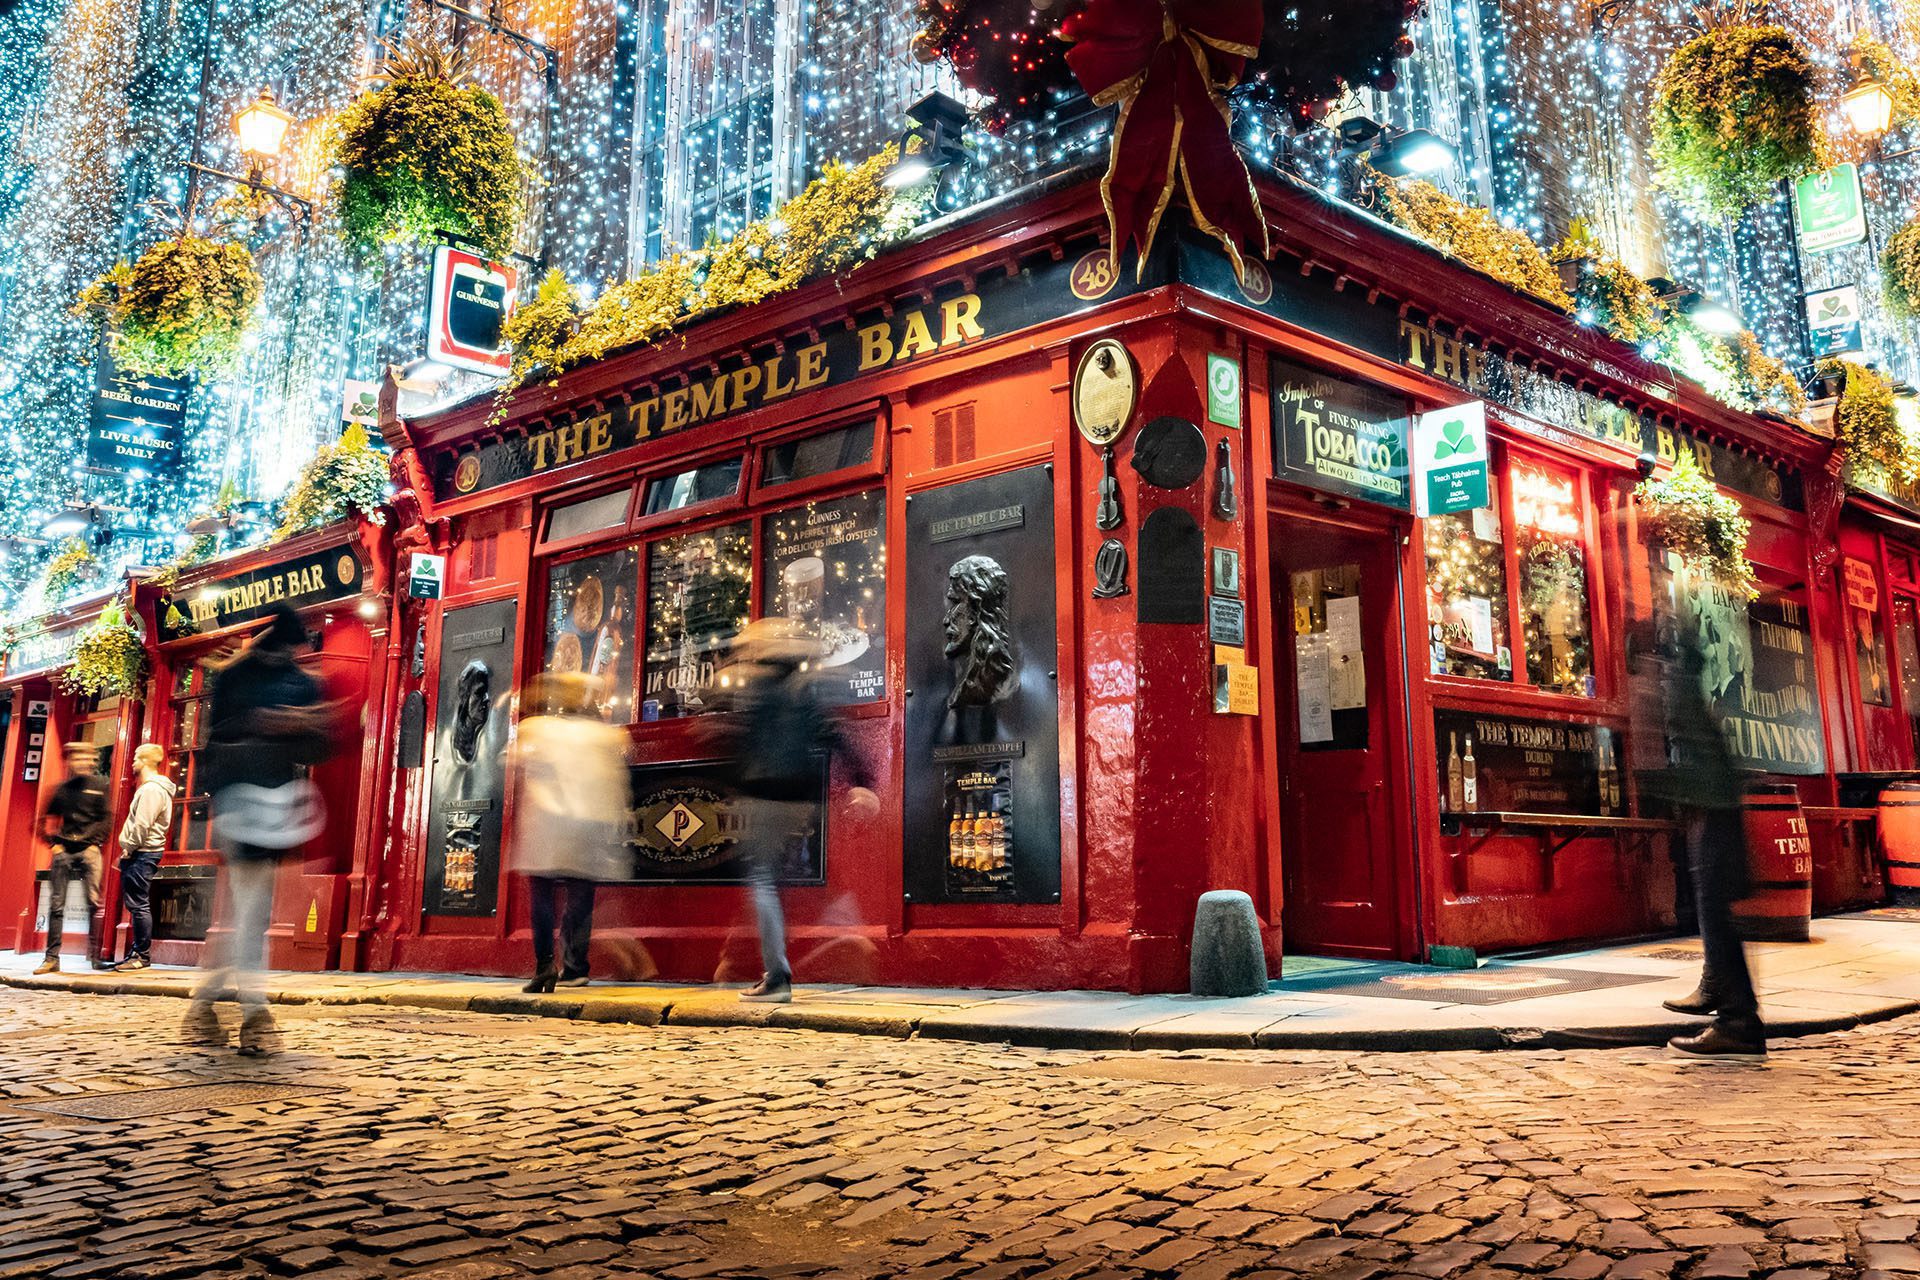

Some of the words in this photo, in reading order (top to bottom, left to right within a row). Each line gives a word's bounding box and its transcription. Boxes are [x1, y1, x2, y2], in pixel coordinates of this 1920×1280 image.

[1078, 258, 1112, 293] 48
[456, 290, 500, 309] GUINNESS
[1400, 318, 1489, 393] THE
[528, 412, 613, 471] THE
[629, 341, 831, 440] TEMPLE
[858, 293, 985, 371] BAR
[101, 389, 132, 403] BEER
[133, 396, 181, 412] GARDEN
[1280, 381, 1334, 409] Importers
[1314, 399, 1325, 410] OF
[1328, 410, 1350, 429] FINE
[1350, 417, 1389, 440] SMOKING
[100, 429, 130, 443] LIVE
[132, 435, 174, 450] MUSIC
[1296, 408, 1391, 473] TOBACCO
[115, 445, 156, 459] DAILY
[1318, 460, 1355, 480] Always
[1360, 472, 1369, 482] in
[1372, 474, 1400, 492] Stock
[1433, 473, 1451, 483] Teach
[1451, 480, 1463, 488] Pub
[807, 509, 841, 526] GUINNESS
[932, 521, 951, 535] THE
[954, 510, 996, 530] TEMPLE
[999, 505, 1022, 520] BAR
[793, 532, 800, 541] A
[800, 524, 829, 541] PERFECT
[831, 519, 856, 536] MATCH
[773, 546, 788, 558] FOR
[788, 540, 825, 555] DELICIOUS
[825, 534, 845, 547] IRISH
[845, 527, 878, 542] OYSTERS
[188, 598, 219, 624] THE
[221, 574, 285, 615] TEMPLE
[286, 563, 326, 598] BAR
[1711, 584, 1738, 613] BAR
[1780, 598, 1800, 625] THE
[848, 676, 884, 689] TEMPLE
[859, 671, 873, 679] THE
[857, 687, 875, 698] BAR
[1476, 720, 1508, 747] THE
[1510, 724, 1566, 751] TEMPLE
[1568, 730, 1594, 752] BAR
[1723, 716, 1820, 766] GUINNESS
[1524, 751, 1554, 765] DUBLIN
[956, 778, 982, 787] TEMPLE
[983, 776, 998, 785] BAR
[672, 809, 690, 842] P
[1787, 817, 1808, 834] TH
[1774, 837, 1810, 855] TEM
